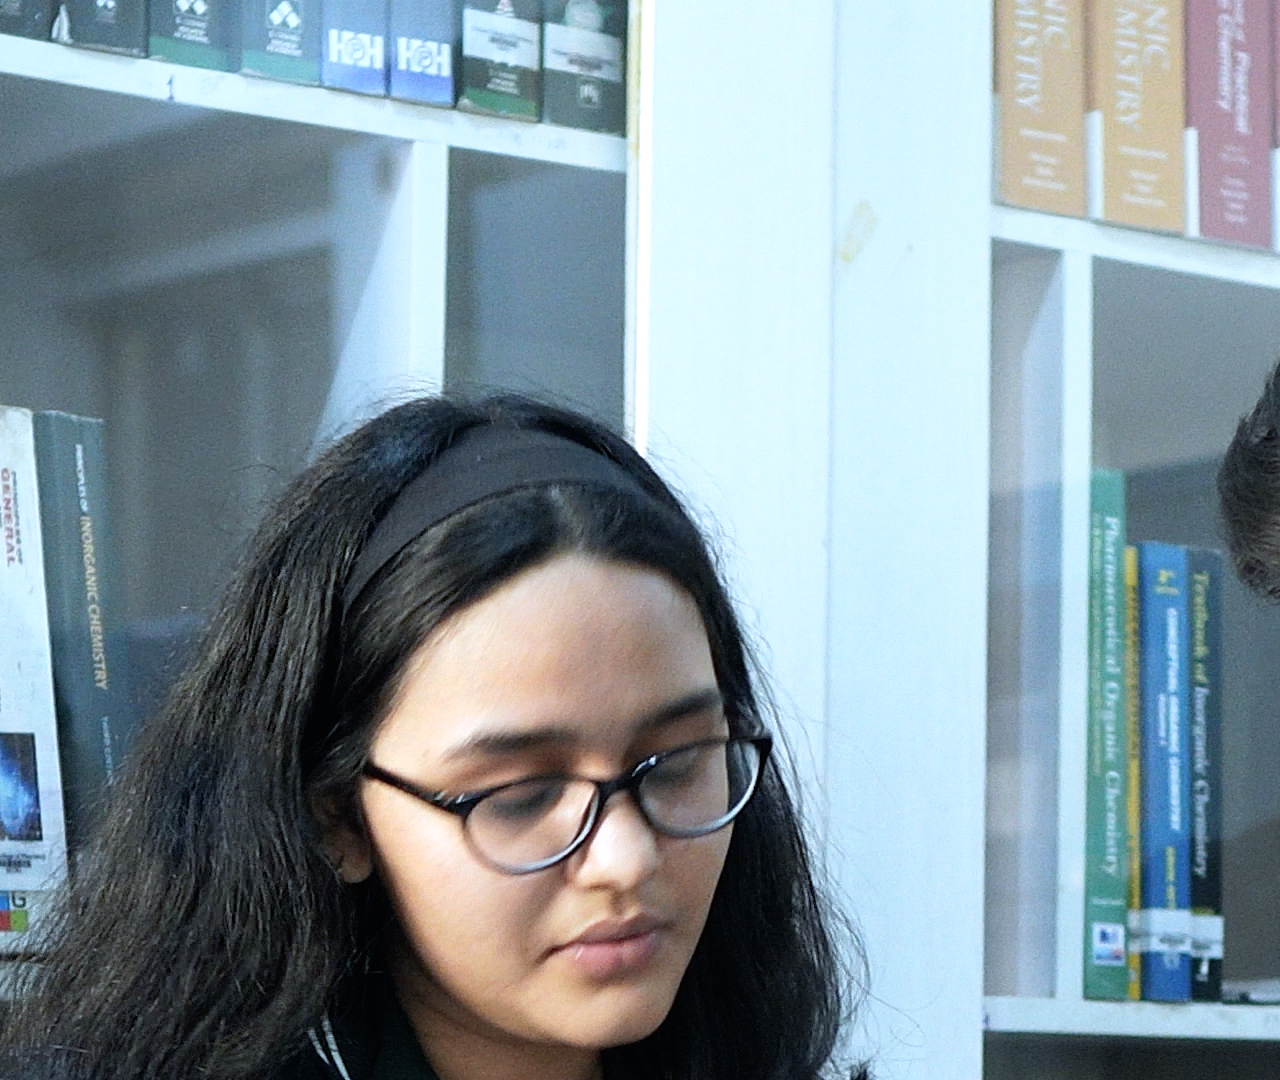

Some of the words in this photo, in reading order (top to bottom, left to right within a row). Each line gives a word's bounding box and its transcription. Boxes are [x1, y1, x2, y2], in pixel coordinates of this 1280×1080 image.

[1, 468, 16, 567] GENERAL
[79, 516, 98, 601] INORGANIC
[88, 604, 108, 690] CHEMISTRY
